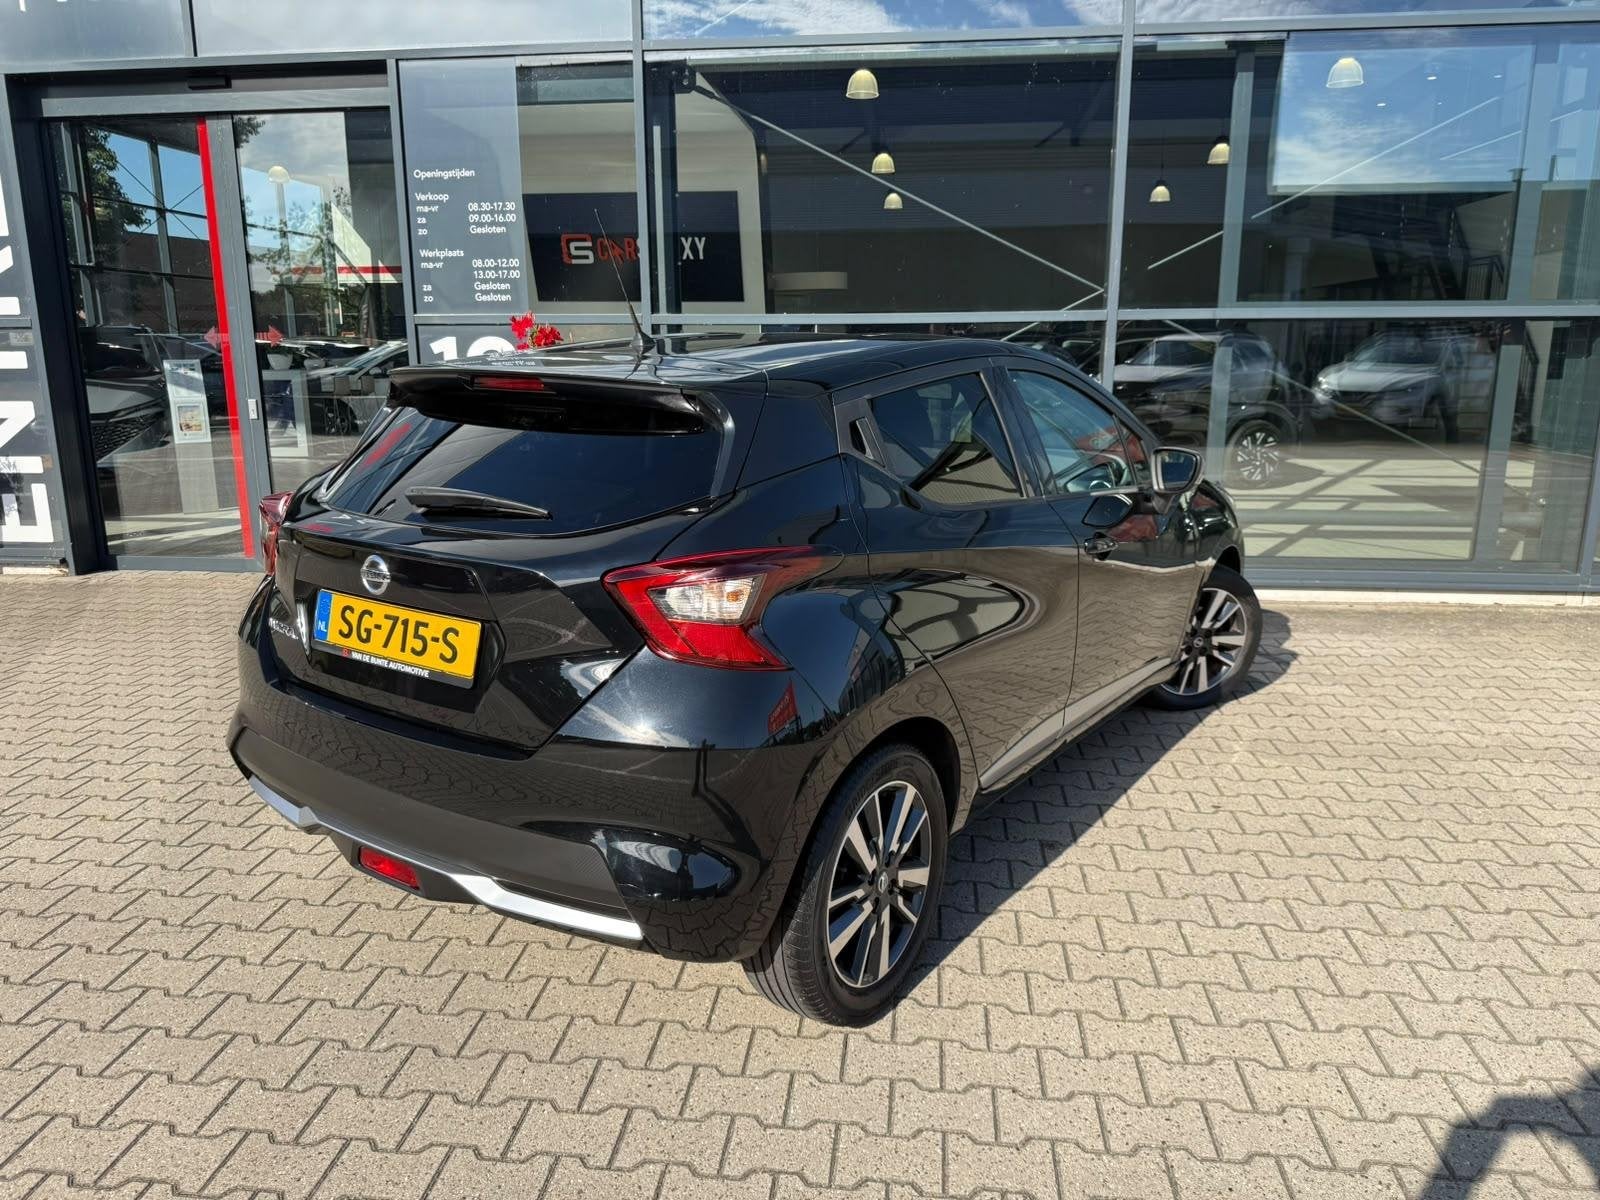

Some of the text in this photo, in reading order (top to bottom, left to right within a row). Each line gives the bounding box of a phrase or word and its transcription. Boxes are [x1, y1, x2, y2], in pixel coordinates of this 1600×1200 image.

[413, 168, 476, 181] Openingstijden
[414, 192, 450, 203] Verkoop
[416, 202, 516, 213] ma-vr 08.30-17.30
[468, 213, 517, 223] 09.00-16.00
[417, 225, 507, 236] zo Gesloten
[419, 248, 465, 260] Werkplaats
[420, 258, 520, 269] ma-vr 08.00-12.00
[473, 270, 521, 279] 13.00-17.00
[422, 281, 511, 292] za Gesloten
[423, 293, 512, 303] zo Gesloten
[317, 619, 328, 633] NL
[338, 604, 460, 664] SG-715-S
[351, 650, 362, 661] VAN
[362, 653, 370, 663] DE
[371, 655, 389, 668] BUNTE
[388, 660, 430, 678] AUTOMOTIVE
